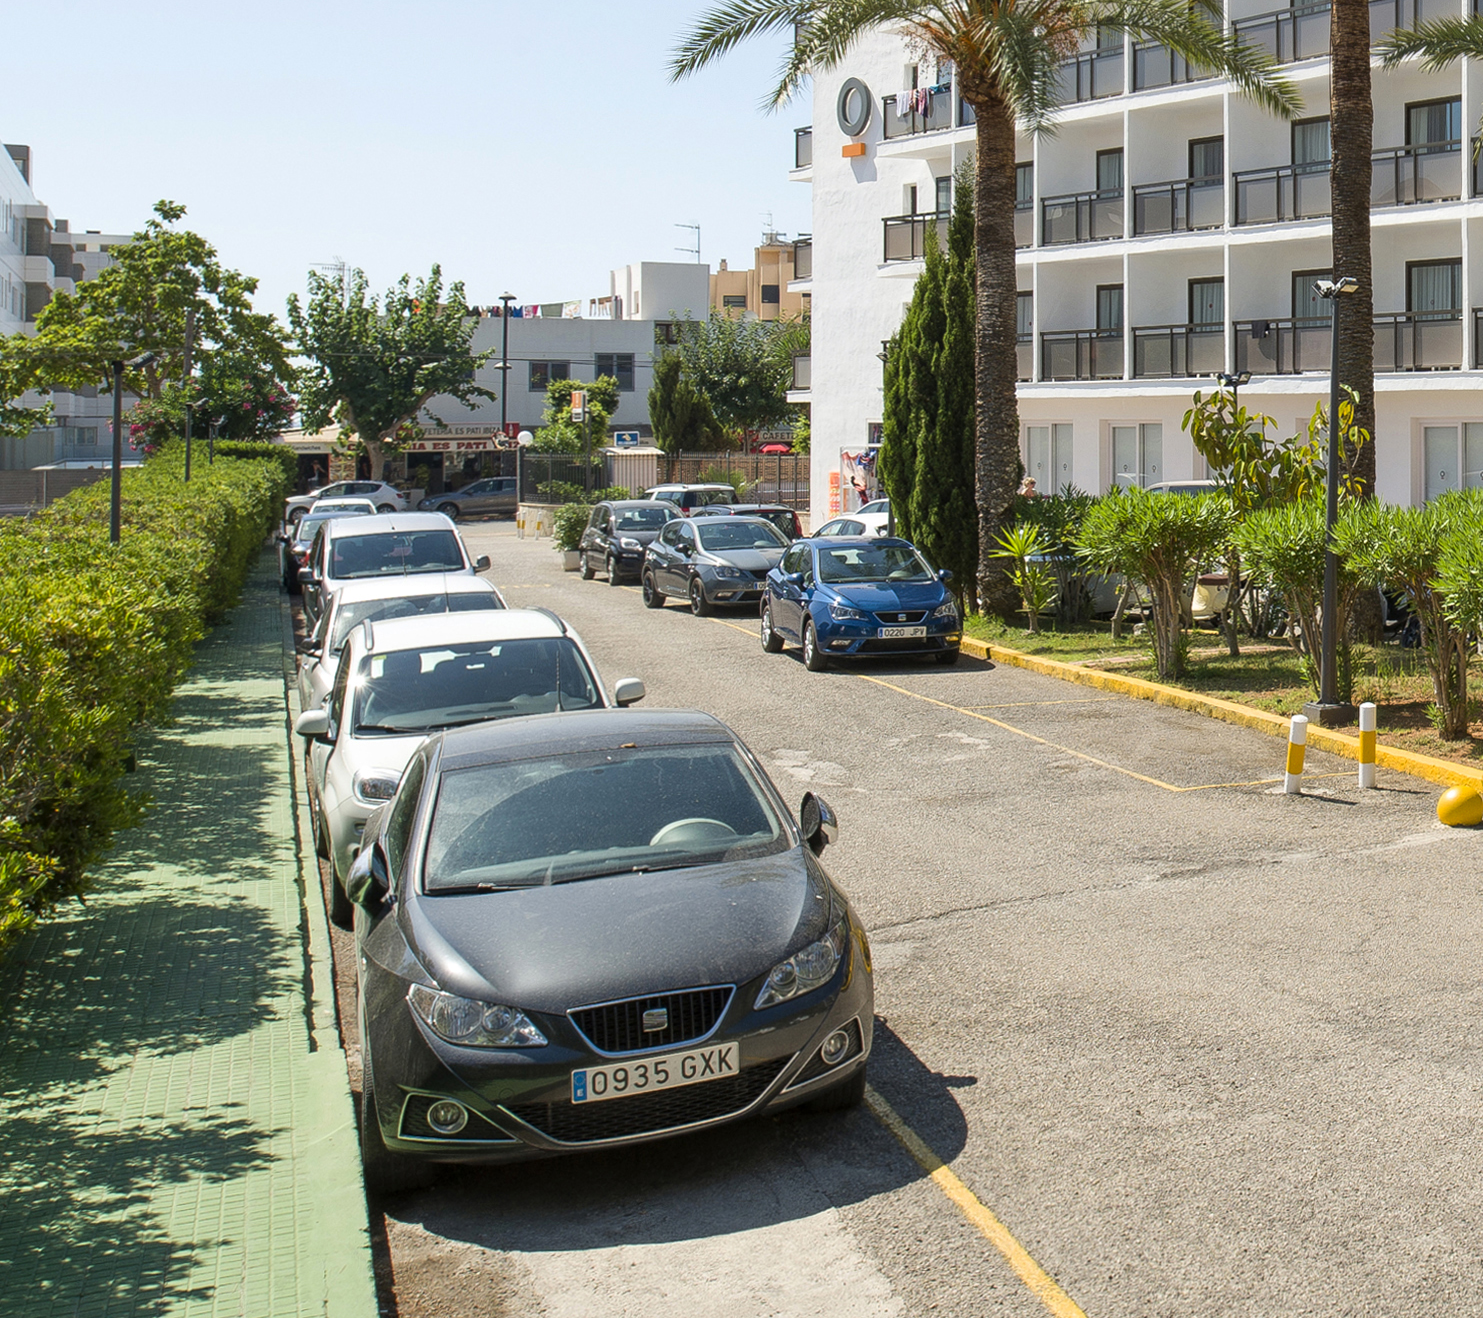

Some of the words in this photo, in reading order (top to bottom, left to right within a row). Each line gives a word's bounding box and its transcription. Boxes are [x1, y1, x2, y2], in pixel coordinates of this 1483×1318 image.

[432, 442, 450, 450] ES
[457, 442, 487, 450] PATI
[884, 629, 905, 637] 0220
[909, 628, 925, 637] JPV
[592, 1060, 669, 1095] 0935
[681, 1047, 733, 1079] GXK
